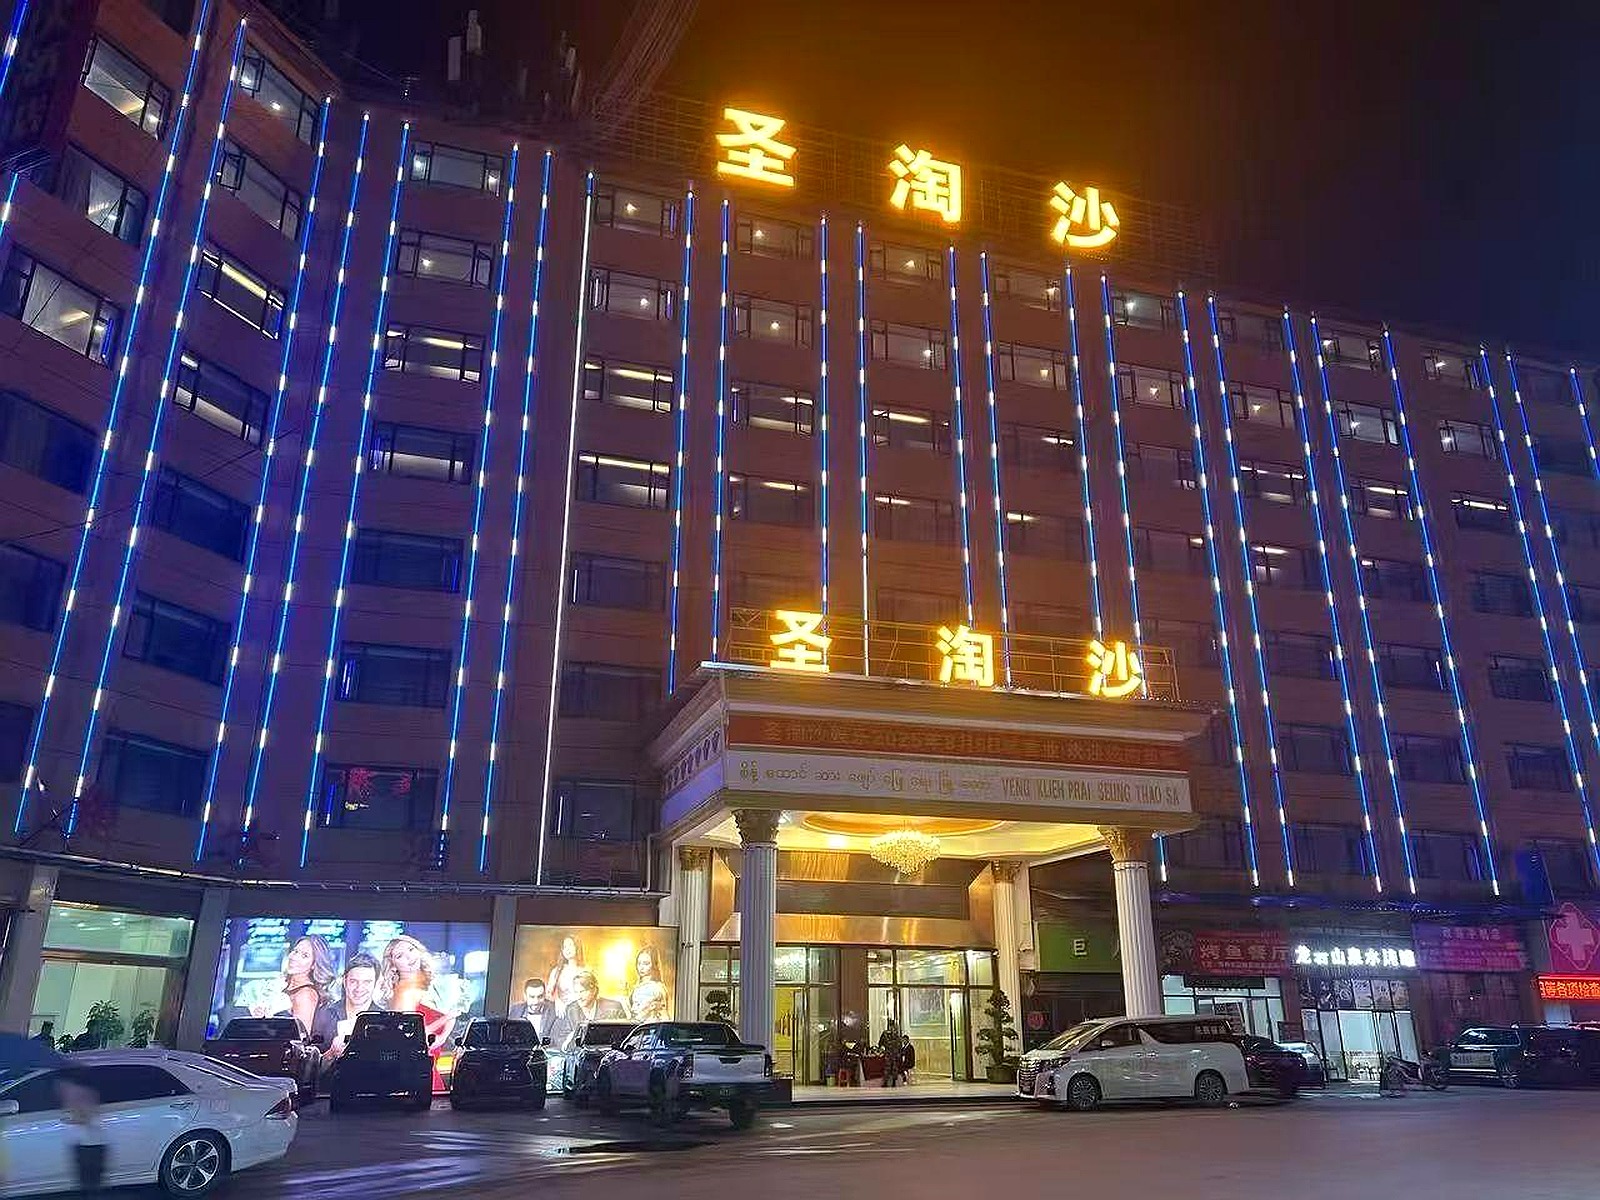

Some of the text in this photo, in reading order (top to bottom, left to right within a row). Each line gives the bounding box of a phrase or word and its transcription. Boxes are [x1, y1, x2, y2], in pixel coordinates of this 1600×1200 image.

[716, 107, 1121, 249] 圣淘沙
[769, 609, 1143, 696] 圣淘沙
